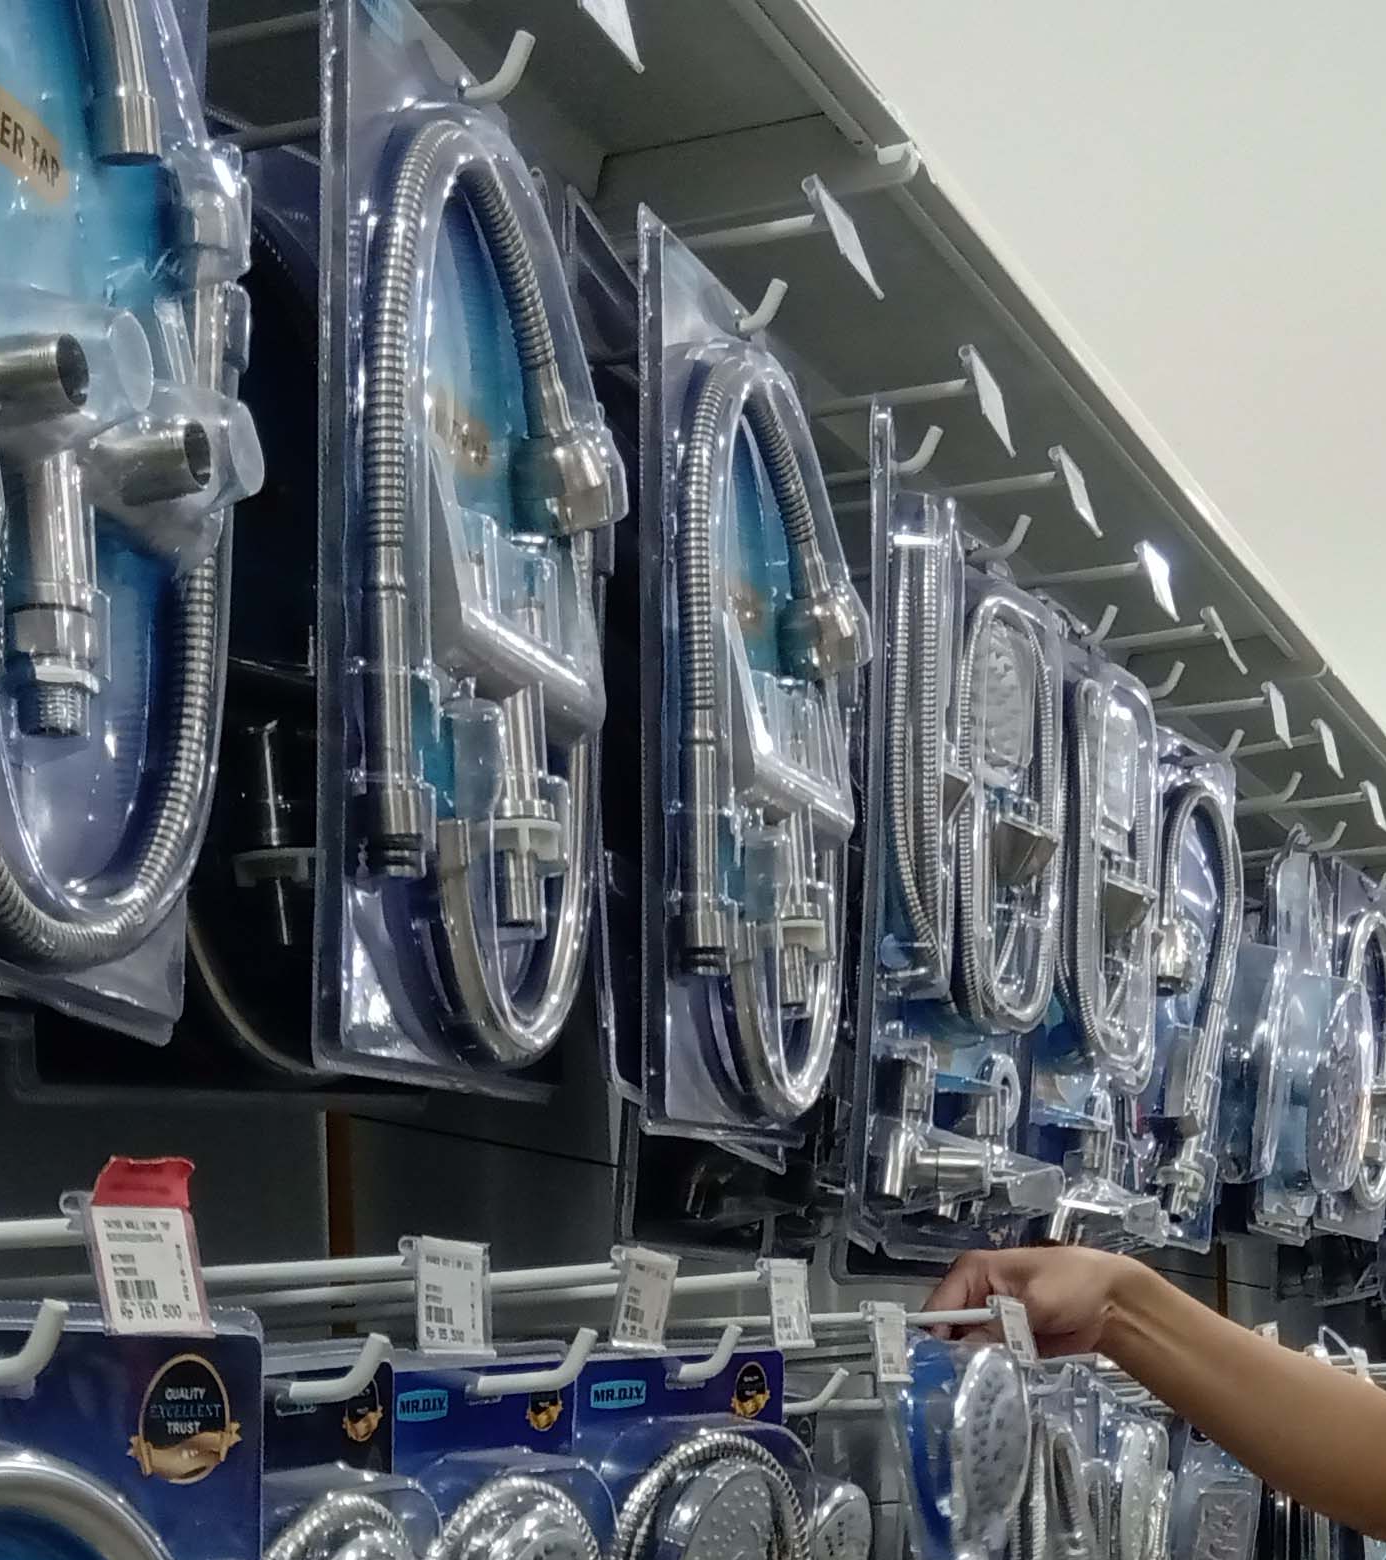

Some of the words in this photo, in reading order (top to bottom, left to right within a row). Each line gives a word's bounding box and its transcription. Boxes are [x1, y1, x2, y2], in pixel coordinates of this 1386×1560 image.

[31, 136, 60, 187] TAP
[165, 1386, 206, 1401] QUALITY
[149, 1402, 222, 1419] EXCELLENT
[166, 1421, 201, 1435] TRUST
